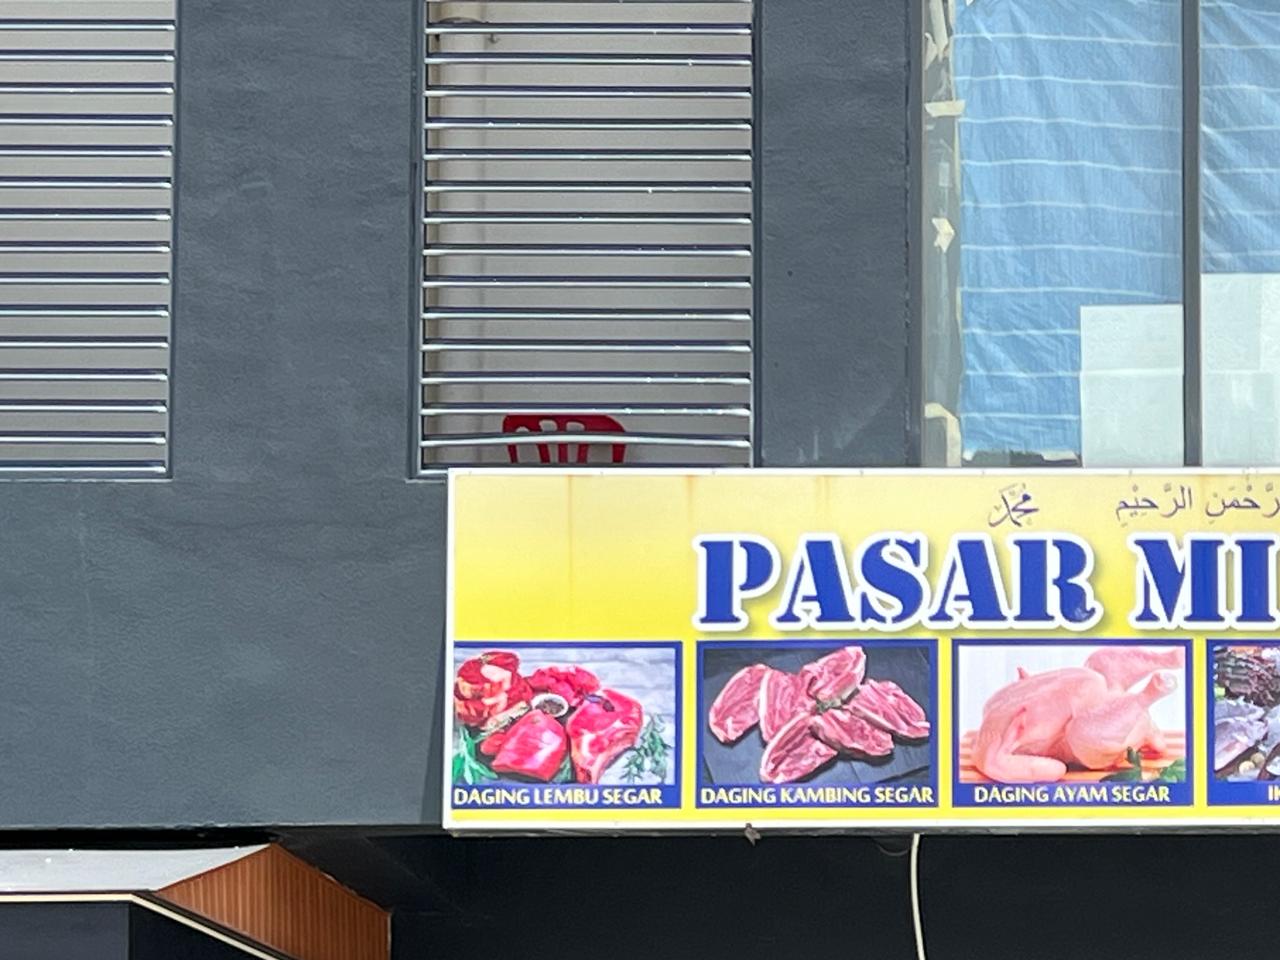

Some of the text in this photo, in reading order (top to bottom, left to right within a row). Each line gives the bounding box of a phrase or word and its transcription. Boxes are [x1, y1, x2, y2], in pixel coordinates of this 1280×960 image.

[700, 539, 1098, 625] PASAR
[454, 787, 662, 805] DAGING LEMBU SEGAR
[701, 786, 934, 804] DAGING KAMBING SEGAR
[974, 786, 1171, 803] DAGING AYAM SEGAR
